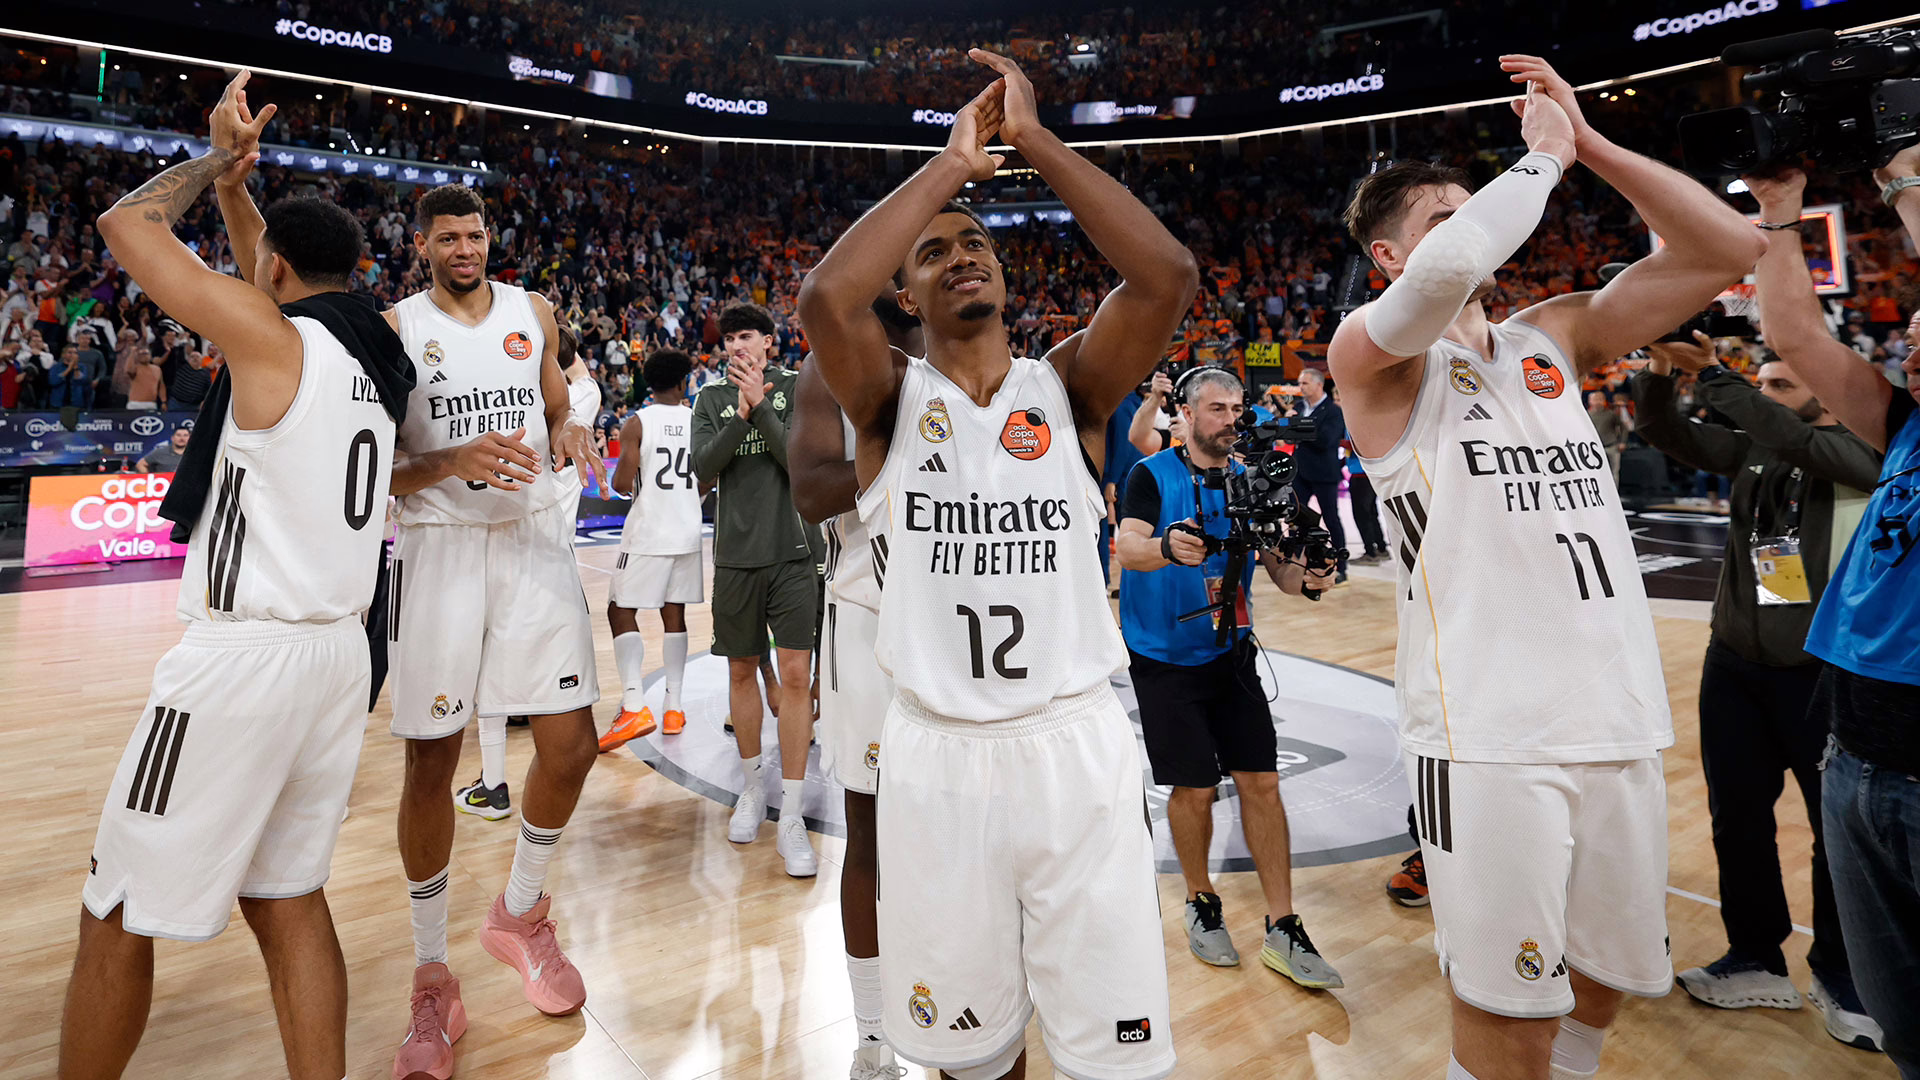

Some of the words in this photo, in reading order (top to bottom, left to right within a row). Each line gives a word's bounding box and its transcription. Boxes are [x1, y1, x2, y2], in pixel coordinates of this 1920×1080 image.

[274, 18, 393, 53] #CopaACB
[554, 69, 576, 85] Rey
[1279, 73, 1384, 103] #CopaACB
[685, 91, 768, 115] #CopaACB
[1137, 104, 1158, 117] Rey
[912, 109, 957, 127] #Cop
[1528, 373, 1549, 382] Copa
[428, 385, 535, 420] Emirates
[449, 416, 472, 440] FLY
[478, 410, 526, 434] BETTER
[664, 425, 684, 437] FELIZ
[1008, 430, 1035, 439] Copa
[1021, 438, 1039, 448] Rey
[344, 428, 378, 531] 0
[655, 447, 693, 490] 24
[101, 473, 170, 500] acb
[1504, 481, 1540, 512] FLY
[1549, 478, 1605, 511] ETTER
[904, 490, 1071, 534] Emirates
[930, 541, 964, 576] FLY
[973, 539, 1058, 576] BETTER
[1555, 532, 1615, 600] 11
[956, 604, 1029, 680] 12
[561, 680, 575, 688] acb
[1120, 1028, 1145, 1041] acb
